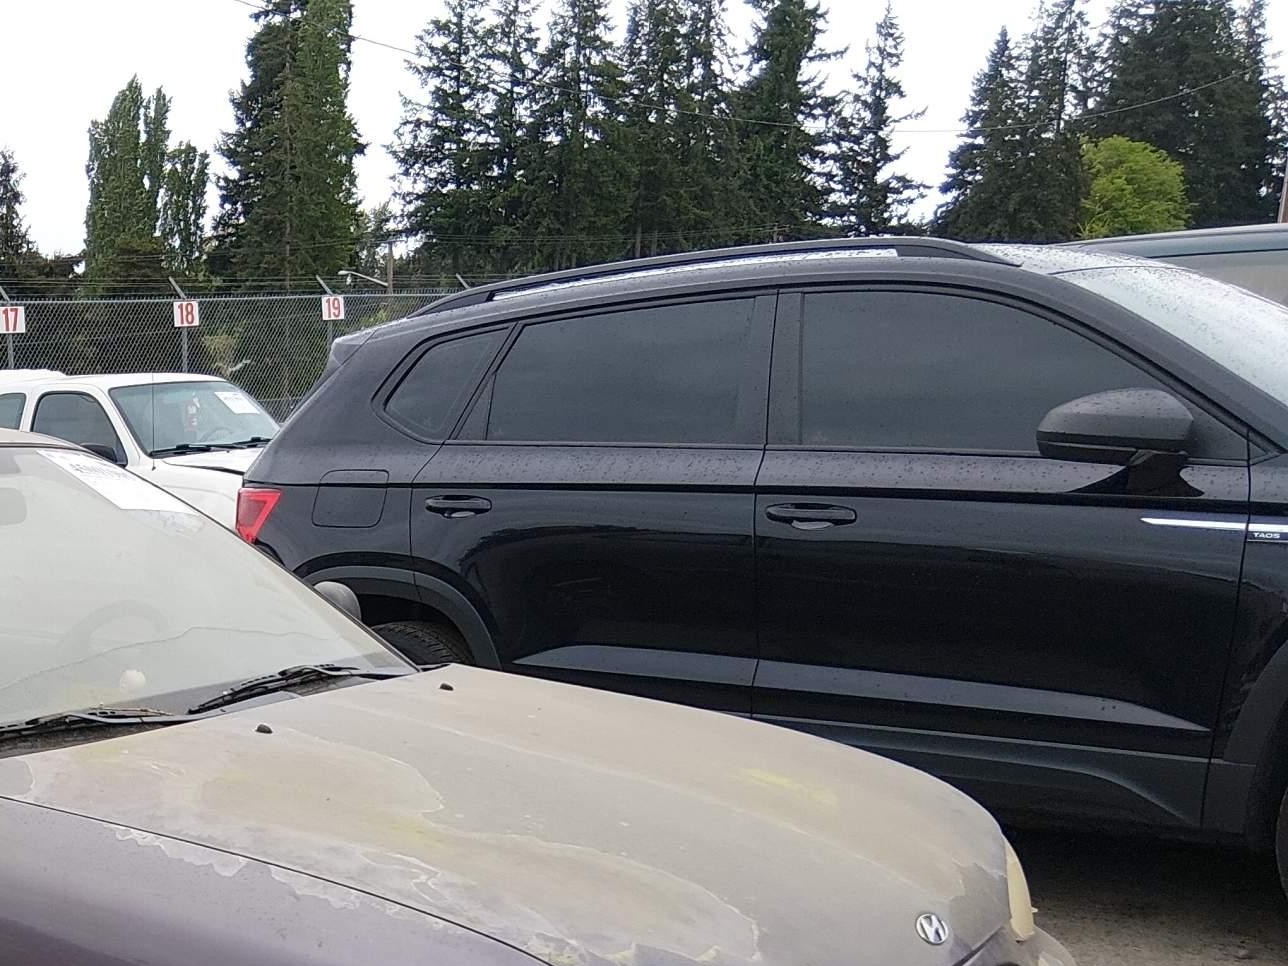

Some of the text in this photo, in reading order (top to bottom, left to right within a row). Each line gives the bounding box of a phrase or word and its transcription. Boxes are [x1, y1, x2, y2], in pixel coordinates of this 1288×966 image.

[2, 307, 19, 332] 17
[177, 302, 195, 325] 18
[325, 297, 341, 319] 19
